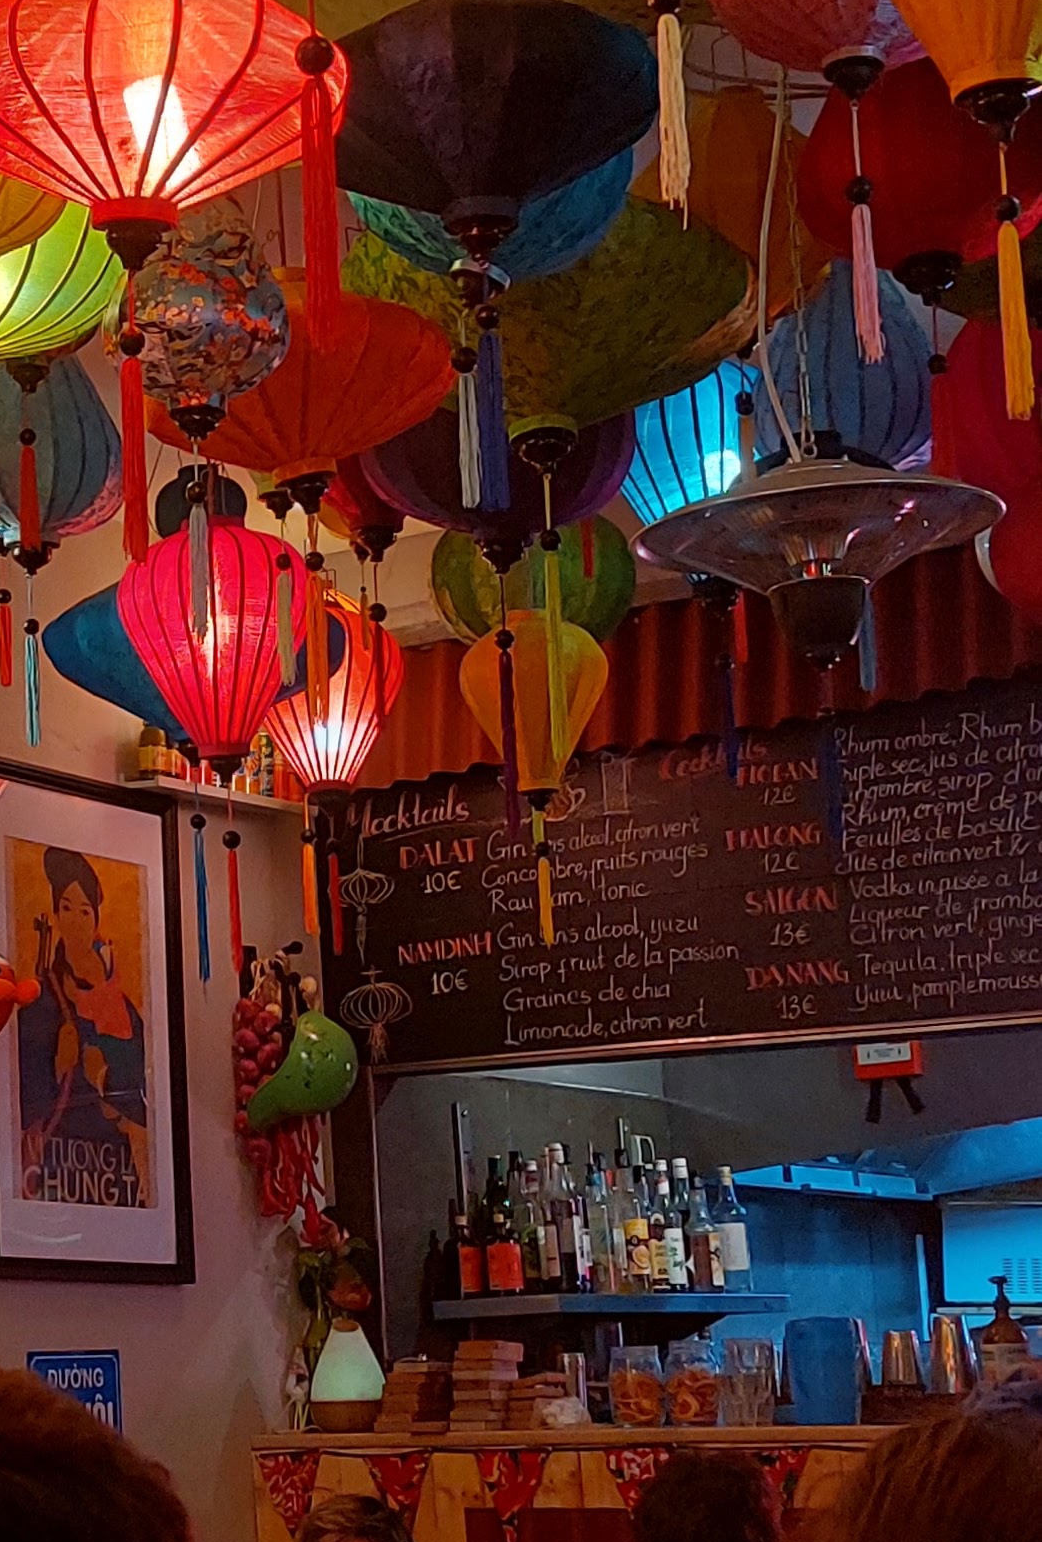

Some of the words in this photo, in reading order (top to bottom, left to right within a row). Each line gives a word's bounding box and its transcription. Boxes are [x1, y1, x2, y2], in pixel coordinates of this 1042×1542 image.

[833, 724, 890, 756] Rhum
[958, 710, 1023, 743] Rhum
[965, 741, 990, 767] de
[347, 783, 471, 837] Mocktails
[762, 784, 796, 805] 12€
[989, 785, 1018, 811] de
[925, 815, 953, 843] de
[958, 808, 1041, 839] basilic
[399, 836, 480, 870] DALAT
[486, 830, 527, 861] Gin
[641, 843, 709, 878] rouges
[835, 850, 879, 875] Jus
[881, 847, 908, 870] de
[963, 835, 1003, 861] vert
[763, 852, 801, 874] 12€
[849, 871, 914, 900] Vodka
[1019, 858, 1040, 884] la
[423, 871, 462, 894] 10€
[489, 889, 534, 914] Rau
[598, 873, 652, 901] tonic
[849, 902, 930, 929] Liqueur
[935, 892, 963, 917] de
[496, 922, 535, 951] Gin
[650, 916, 699, 944] yuzu
[769, 922, 813, 947] 13€
[499, 955, 551, 983] Sirop
[557, 945, 606, 983] fruit
[614, 941, 642, 969] de
[644, 937, 664, 967] la
[669, 943, 740, 975] passion
[1011, 948, 1041, 965] sec
[431, 969, 469, 995] 10€
[503, 987, 592, 1012] Graines
[598, 974, 628, 1002] de
[632, 973, 671, 1000] chia
[667, 998, 709, 1030] vert
[777, 994, 820, 1020] 13€
